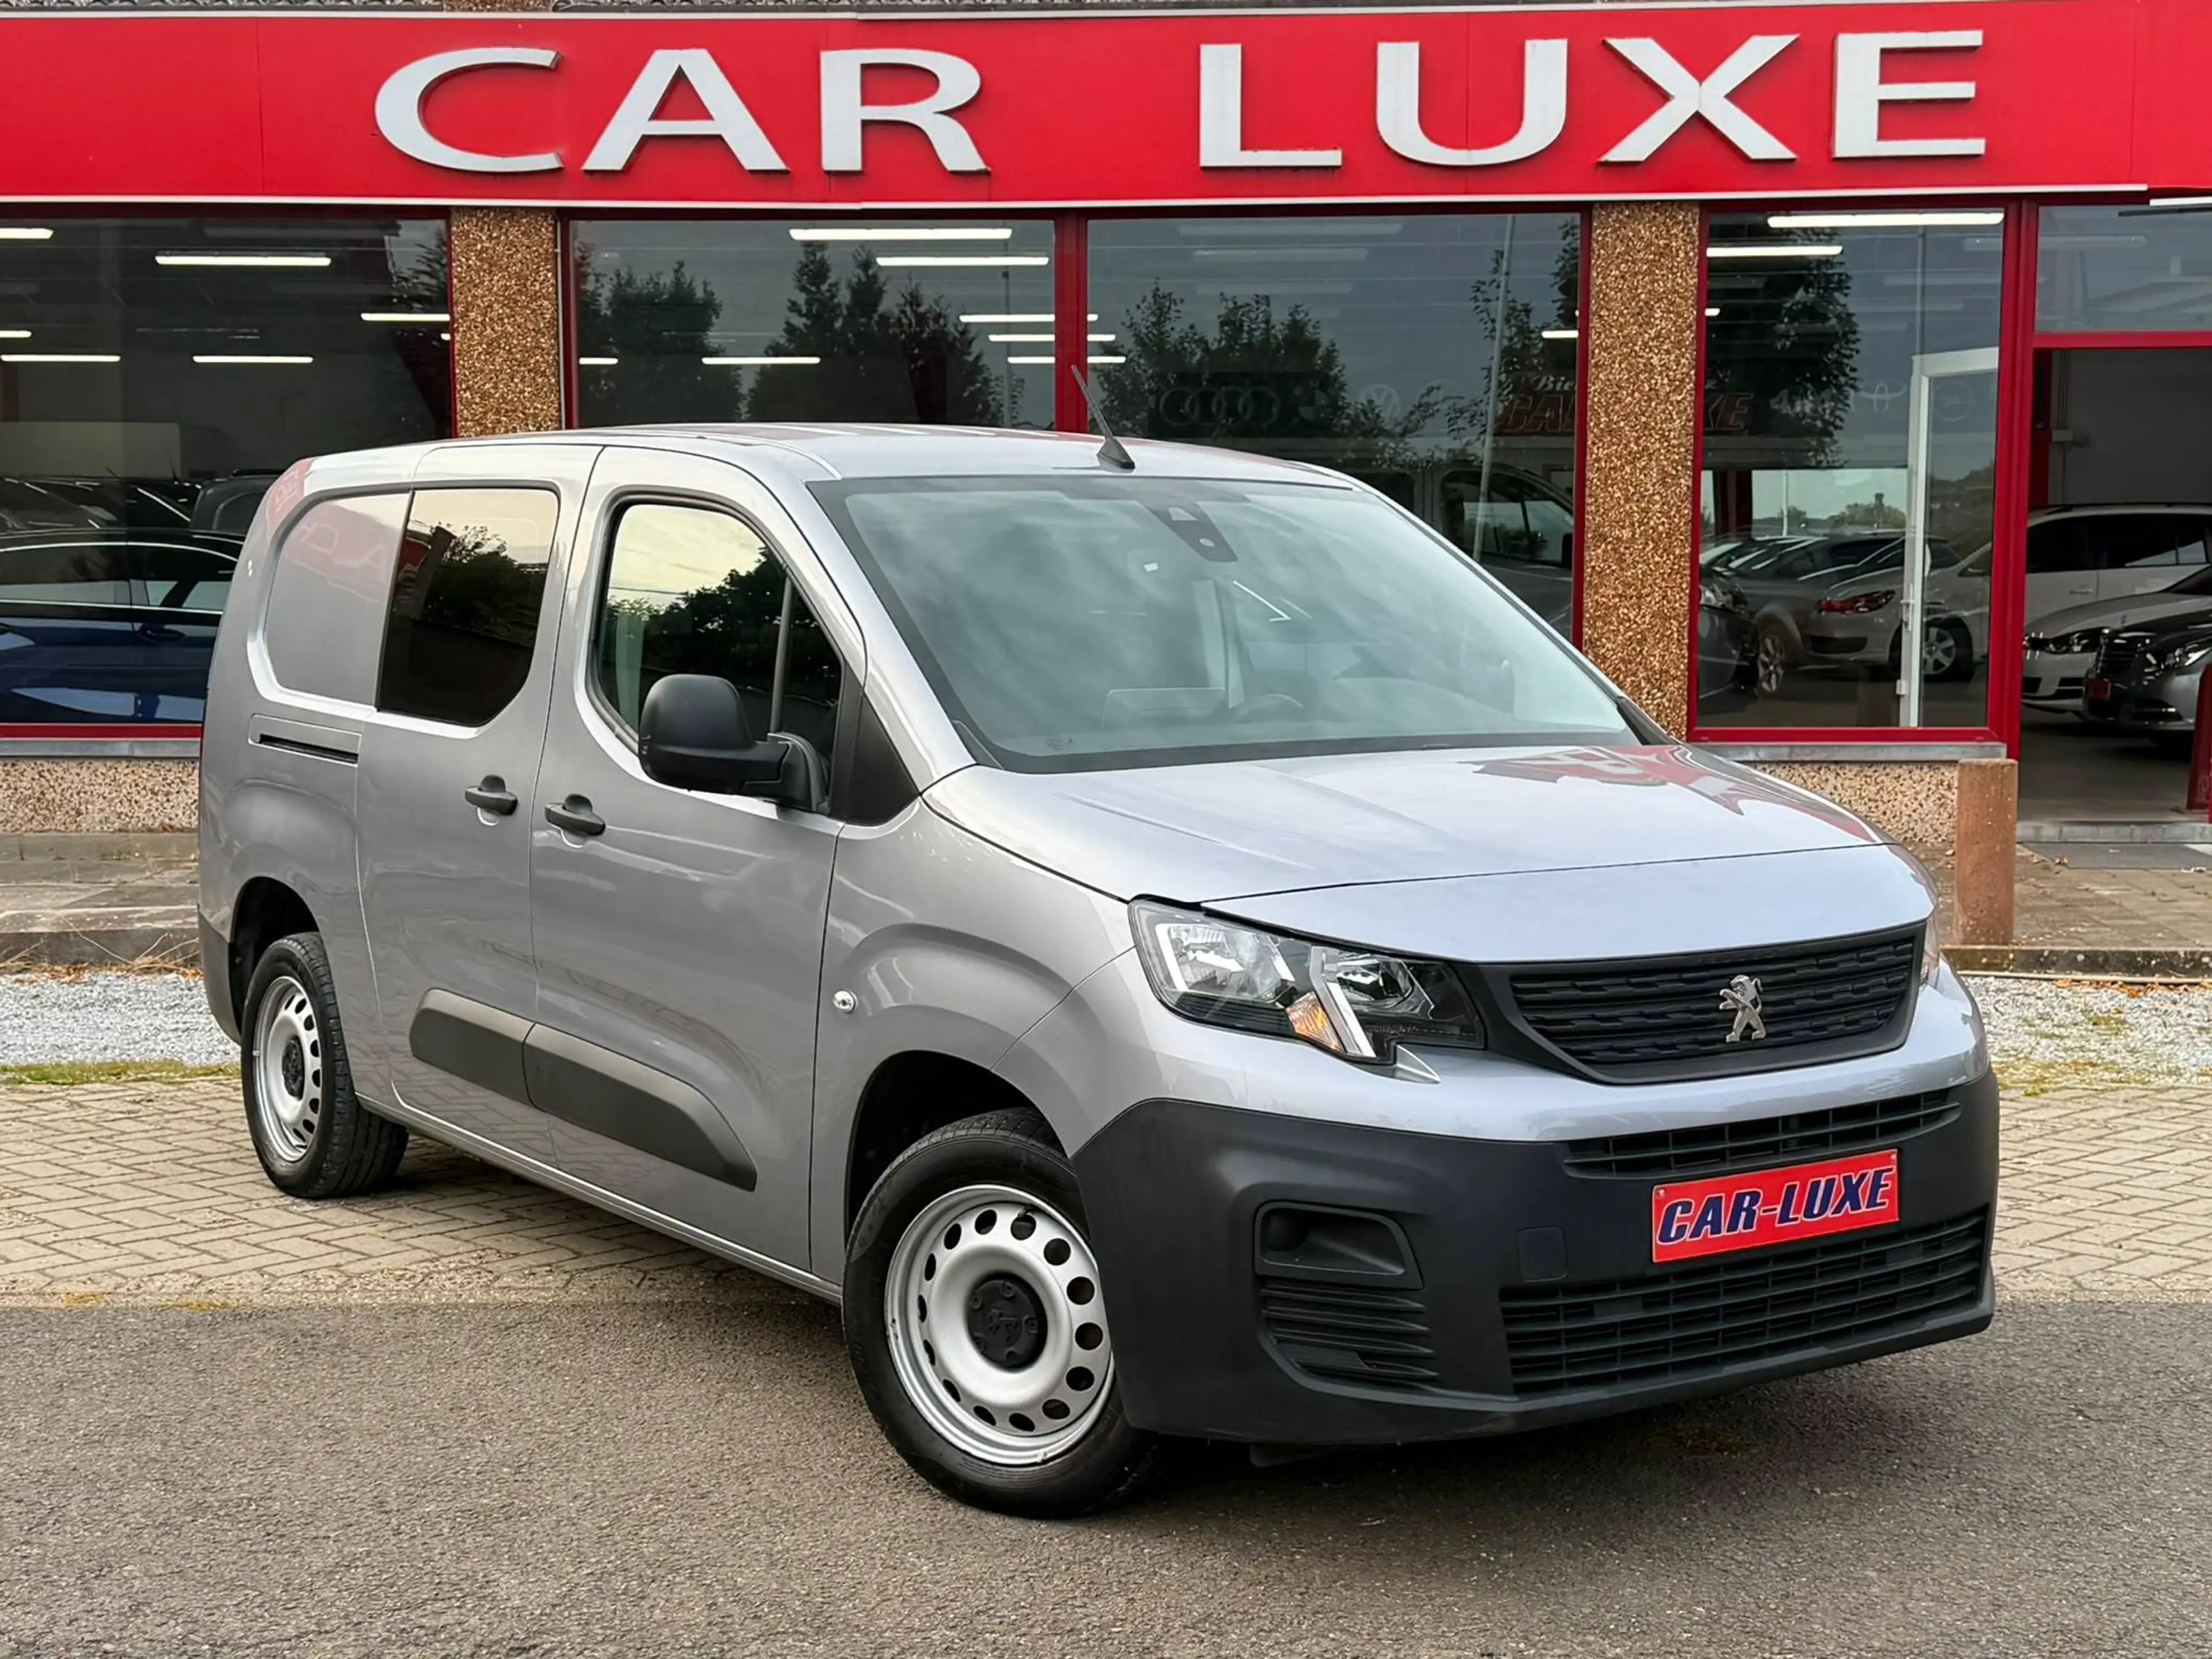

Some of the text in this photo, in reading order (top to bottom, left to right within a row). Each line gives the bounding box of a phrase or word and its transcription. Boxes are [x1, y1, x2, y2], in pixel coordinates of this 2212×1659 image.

[374, 29, 1987, 174] CAR LUXE
[1657, 1166, 1895, 1245] CAR-LUXE
